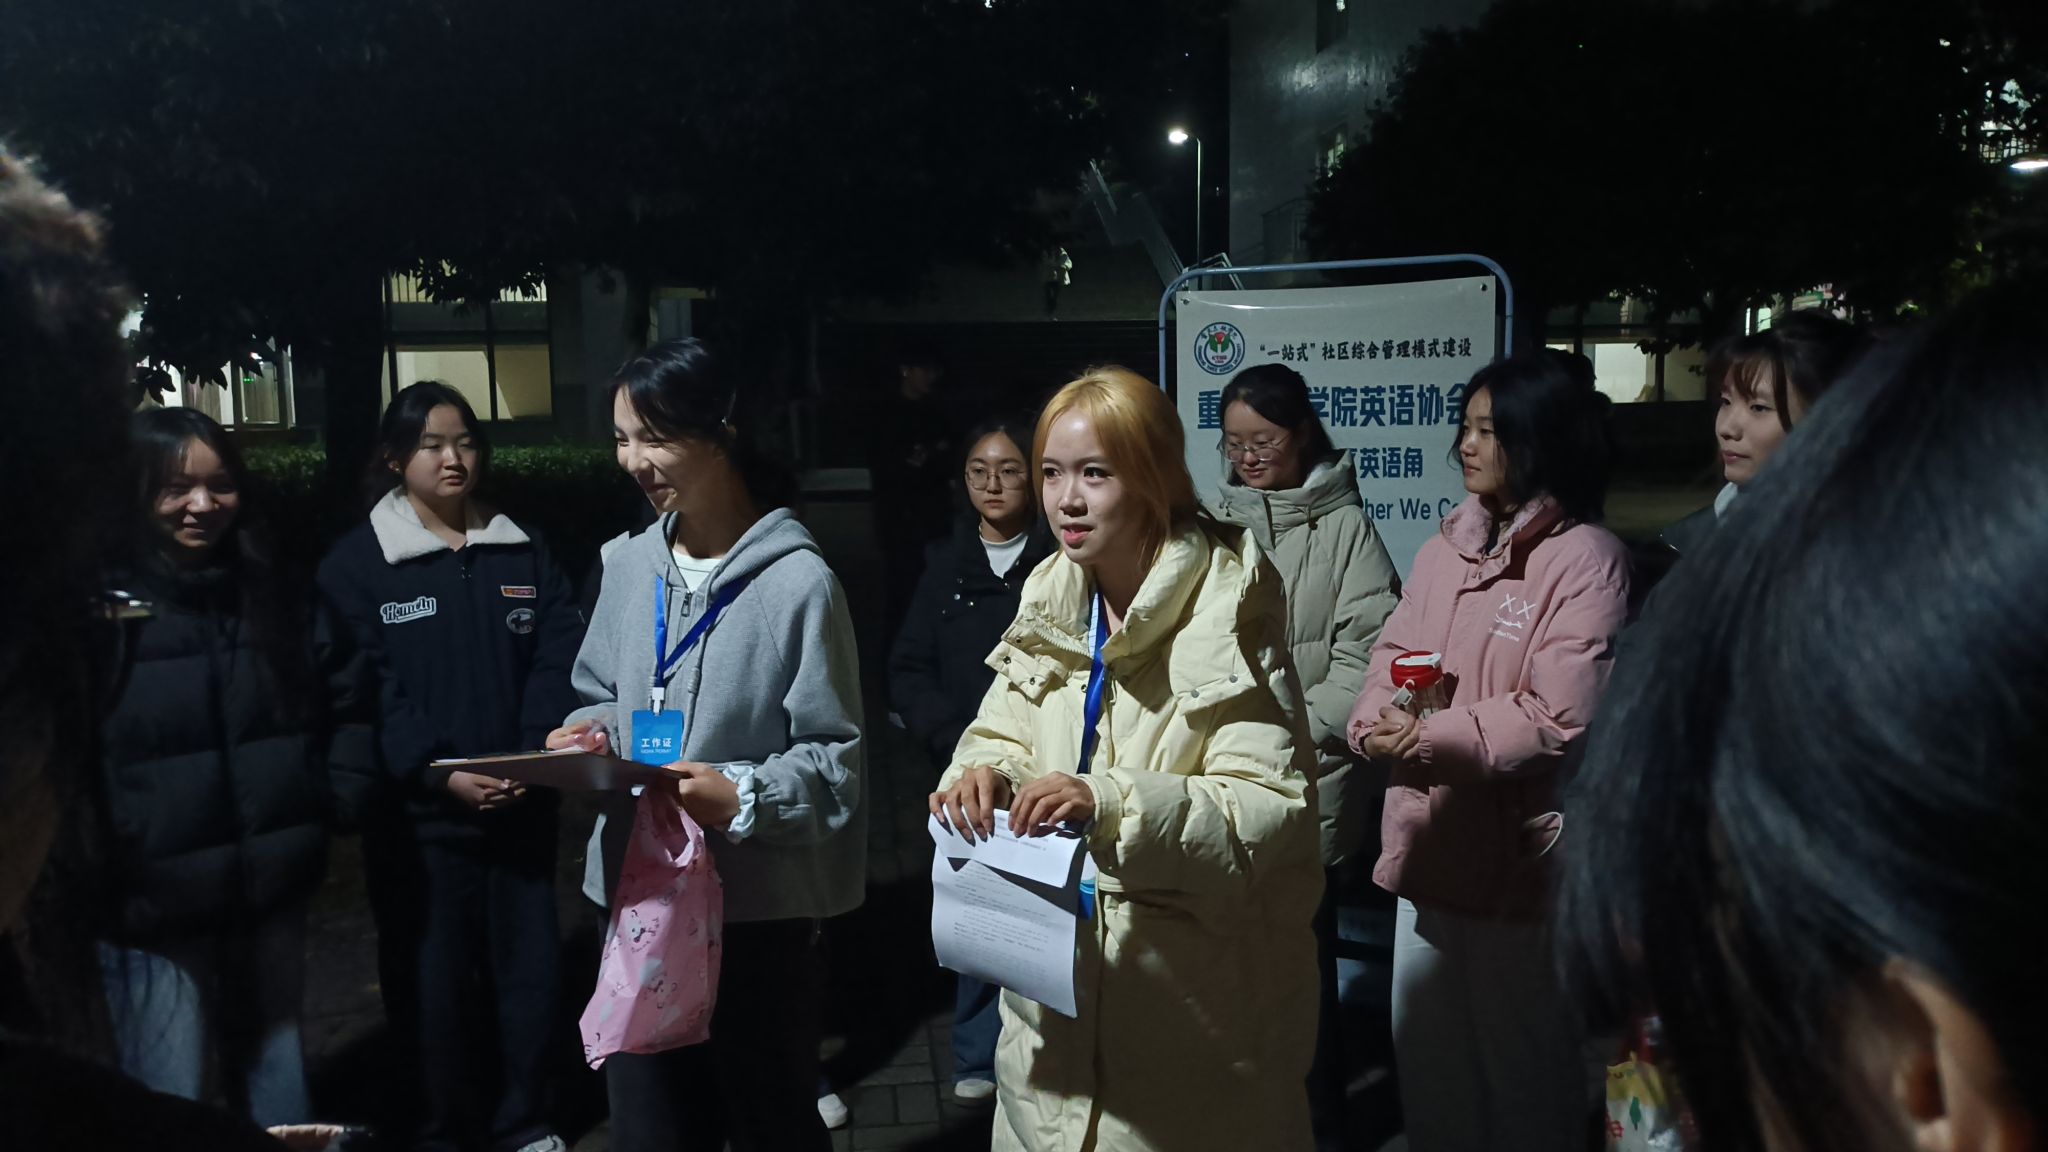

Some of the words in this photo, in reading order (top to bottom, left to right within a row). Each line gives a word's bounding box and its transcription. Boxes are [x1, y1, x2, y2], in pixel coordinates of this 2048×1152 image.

[1198, 384, 1463, 428] 重学院英语协会
[1351, 447, 1423, 478] 英语角
[1365, 498, 1393, 519] her
[1399, 498, 1430, 520] We
[641, 738, 671, 748] 工作证
